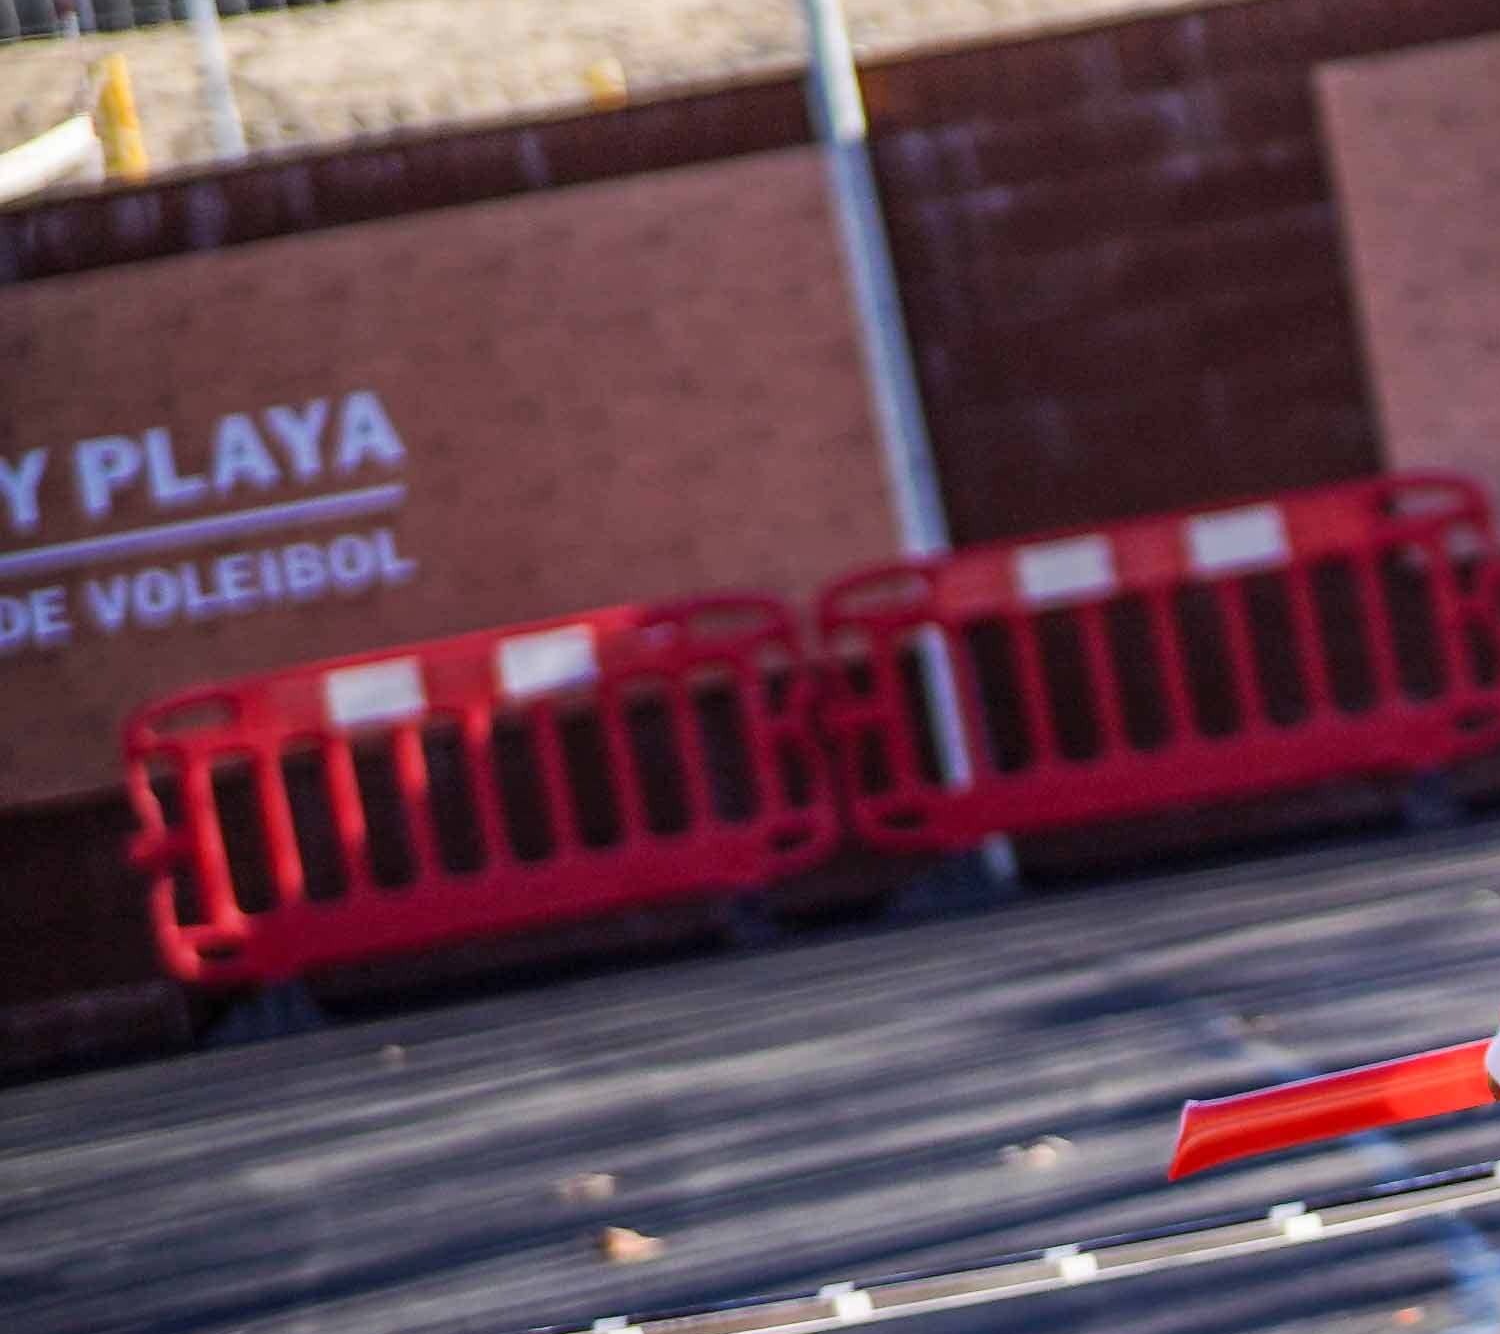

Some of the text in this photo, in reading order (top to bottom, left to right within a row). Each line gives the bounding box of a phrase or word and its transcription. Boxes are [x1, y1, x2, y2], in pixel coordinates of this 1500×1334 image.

[0, 390, 407, 532] Y PLAYA
[84, 527, 416, 635] VOLEIBOL
